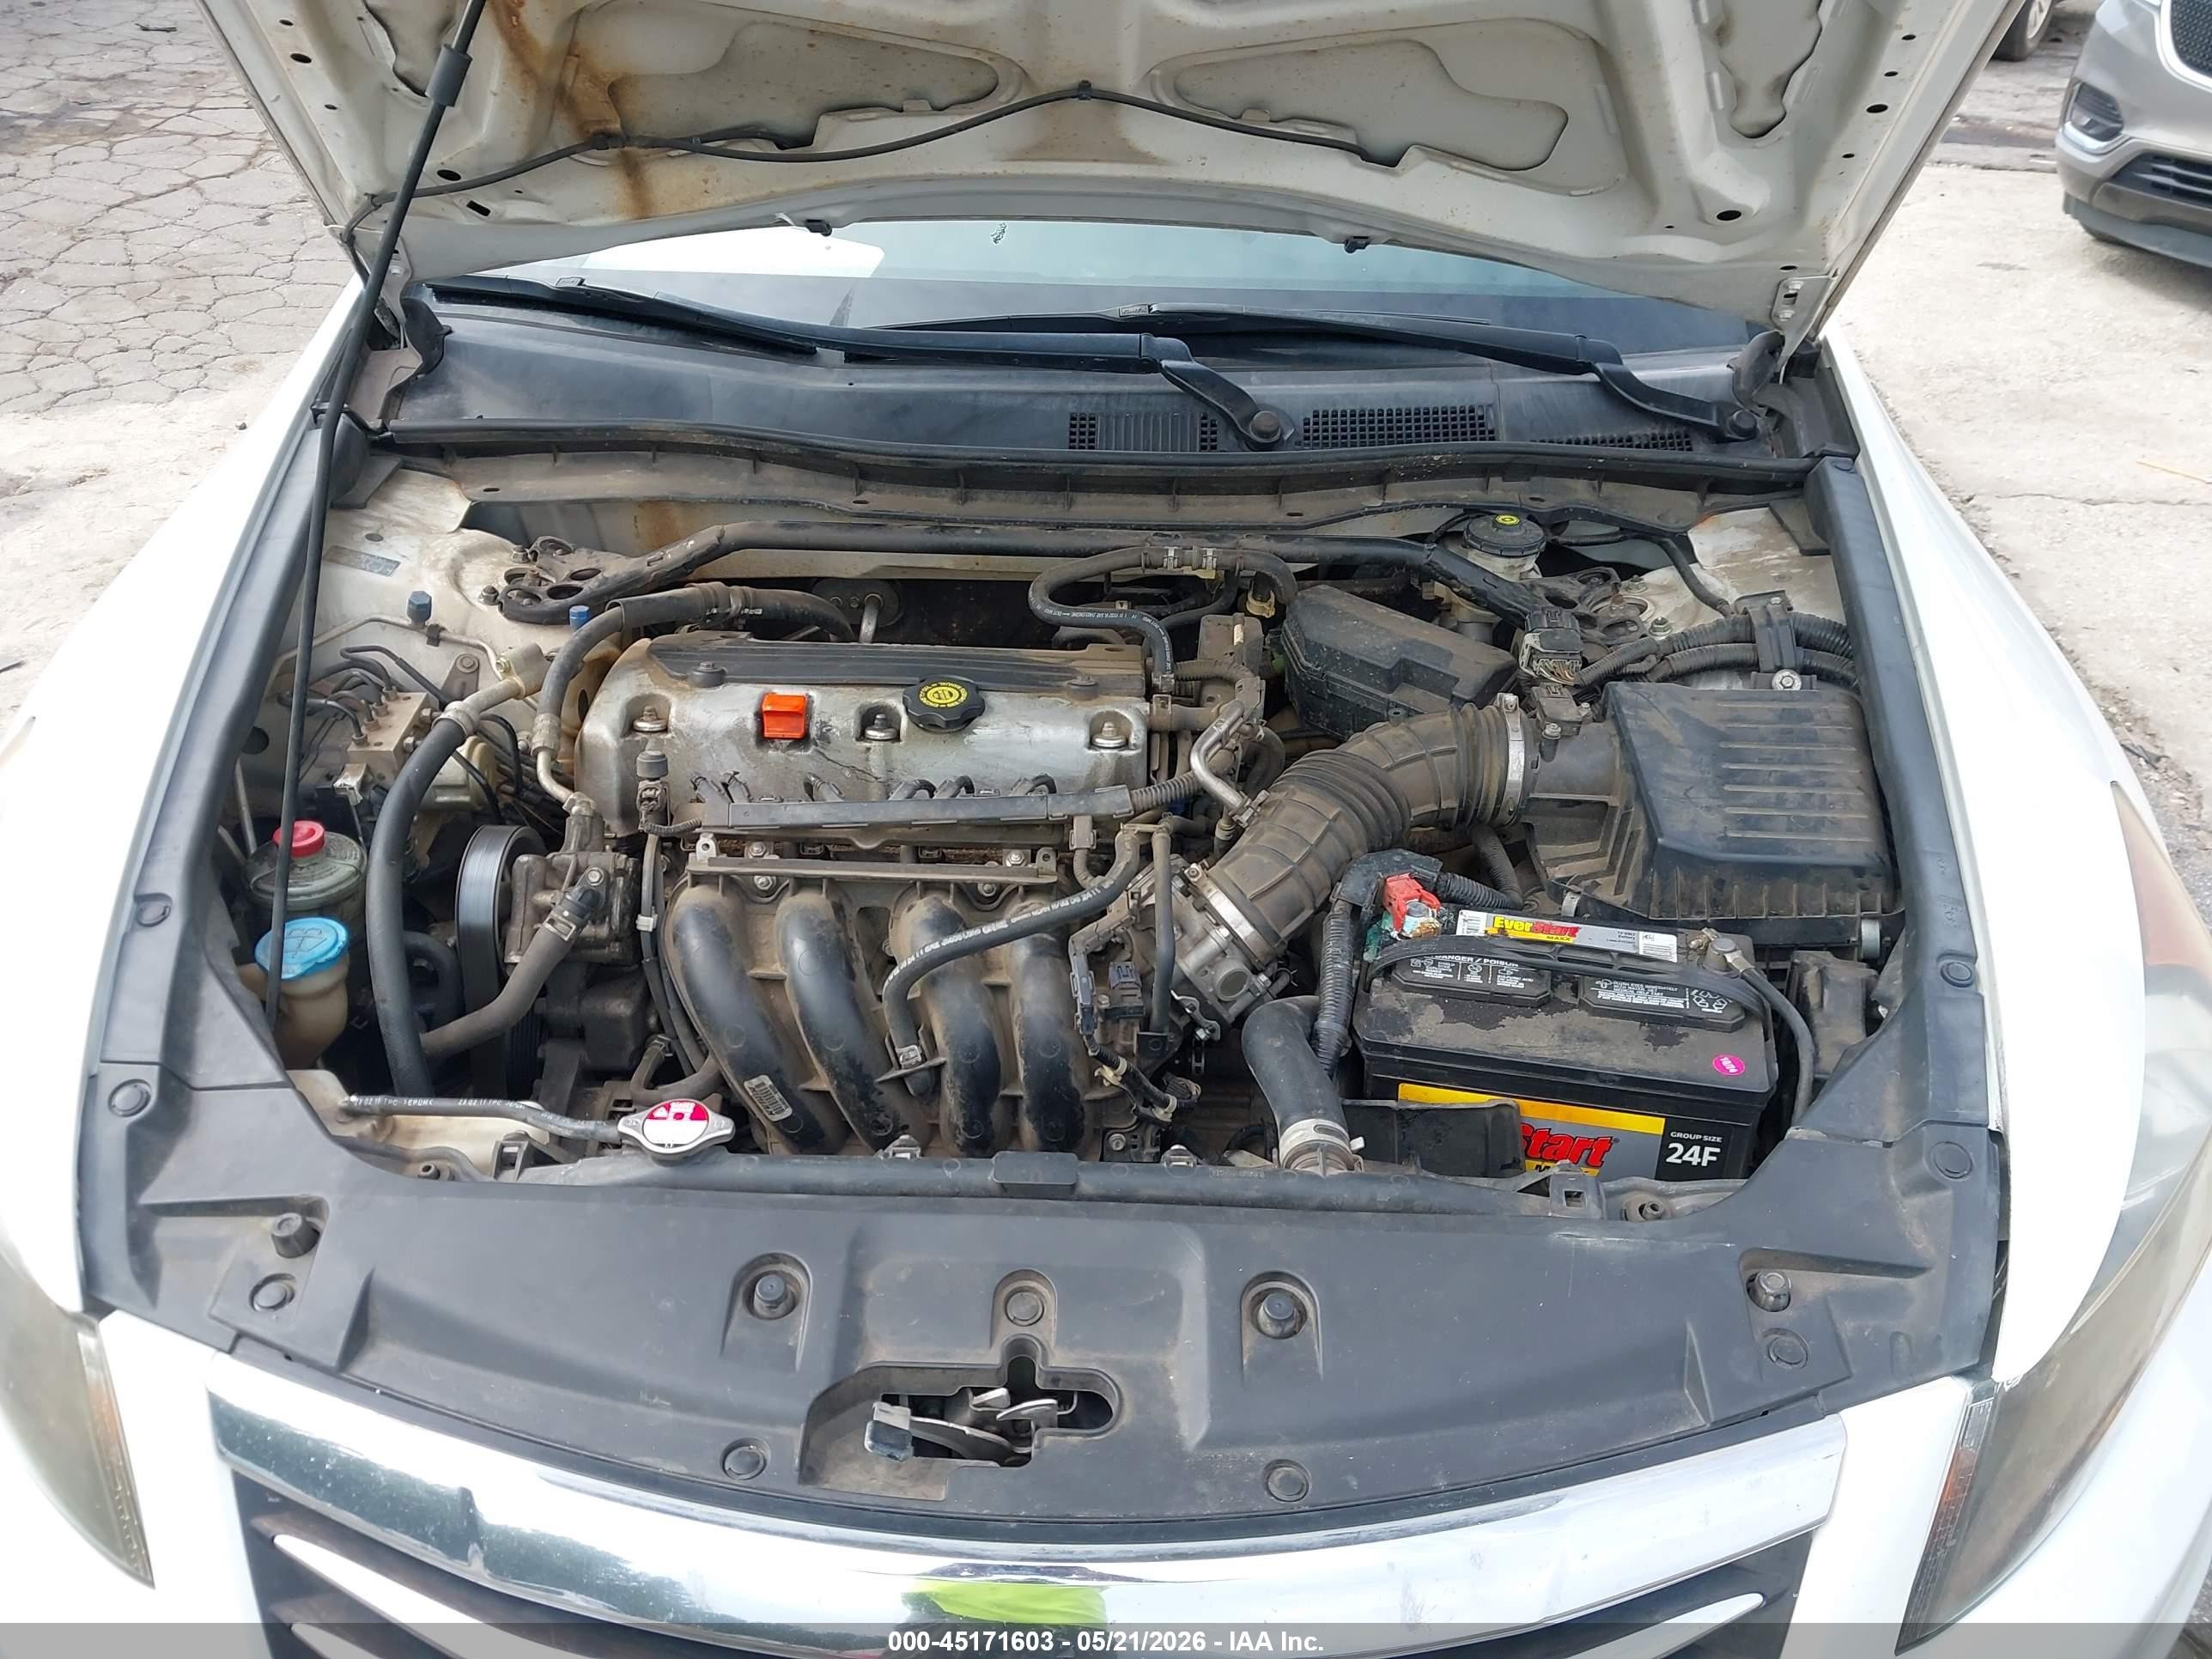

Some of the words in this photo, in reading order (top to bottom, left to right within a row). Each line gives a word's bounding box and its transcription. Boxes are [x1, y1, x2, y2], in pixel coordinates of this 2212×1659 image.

[1493, 915, 1582, 938] EverStart
[1670, 1131, 1702, 1142] GROUP
[1666, 1142, 1721, 1167] 24F
